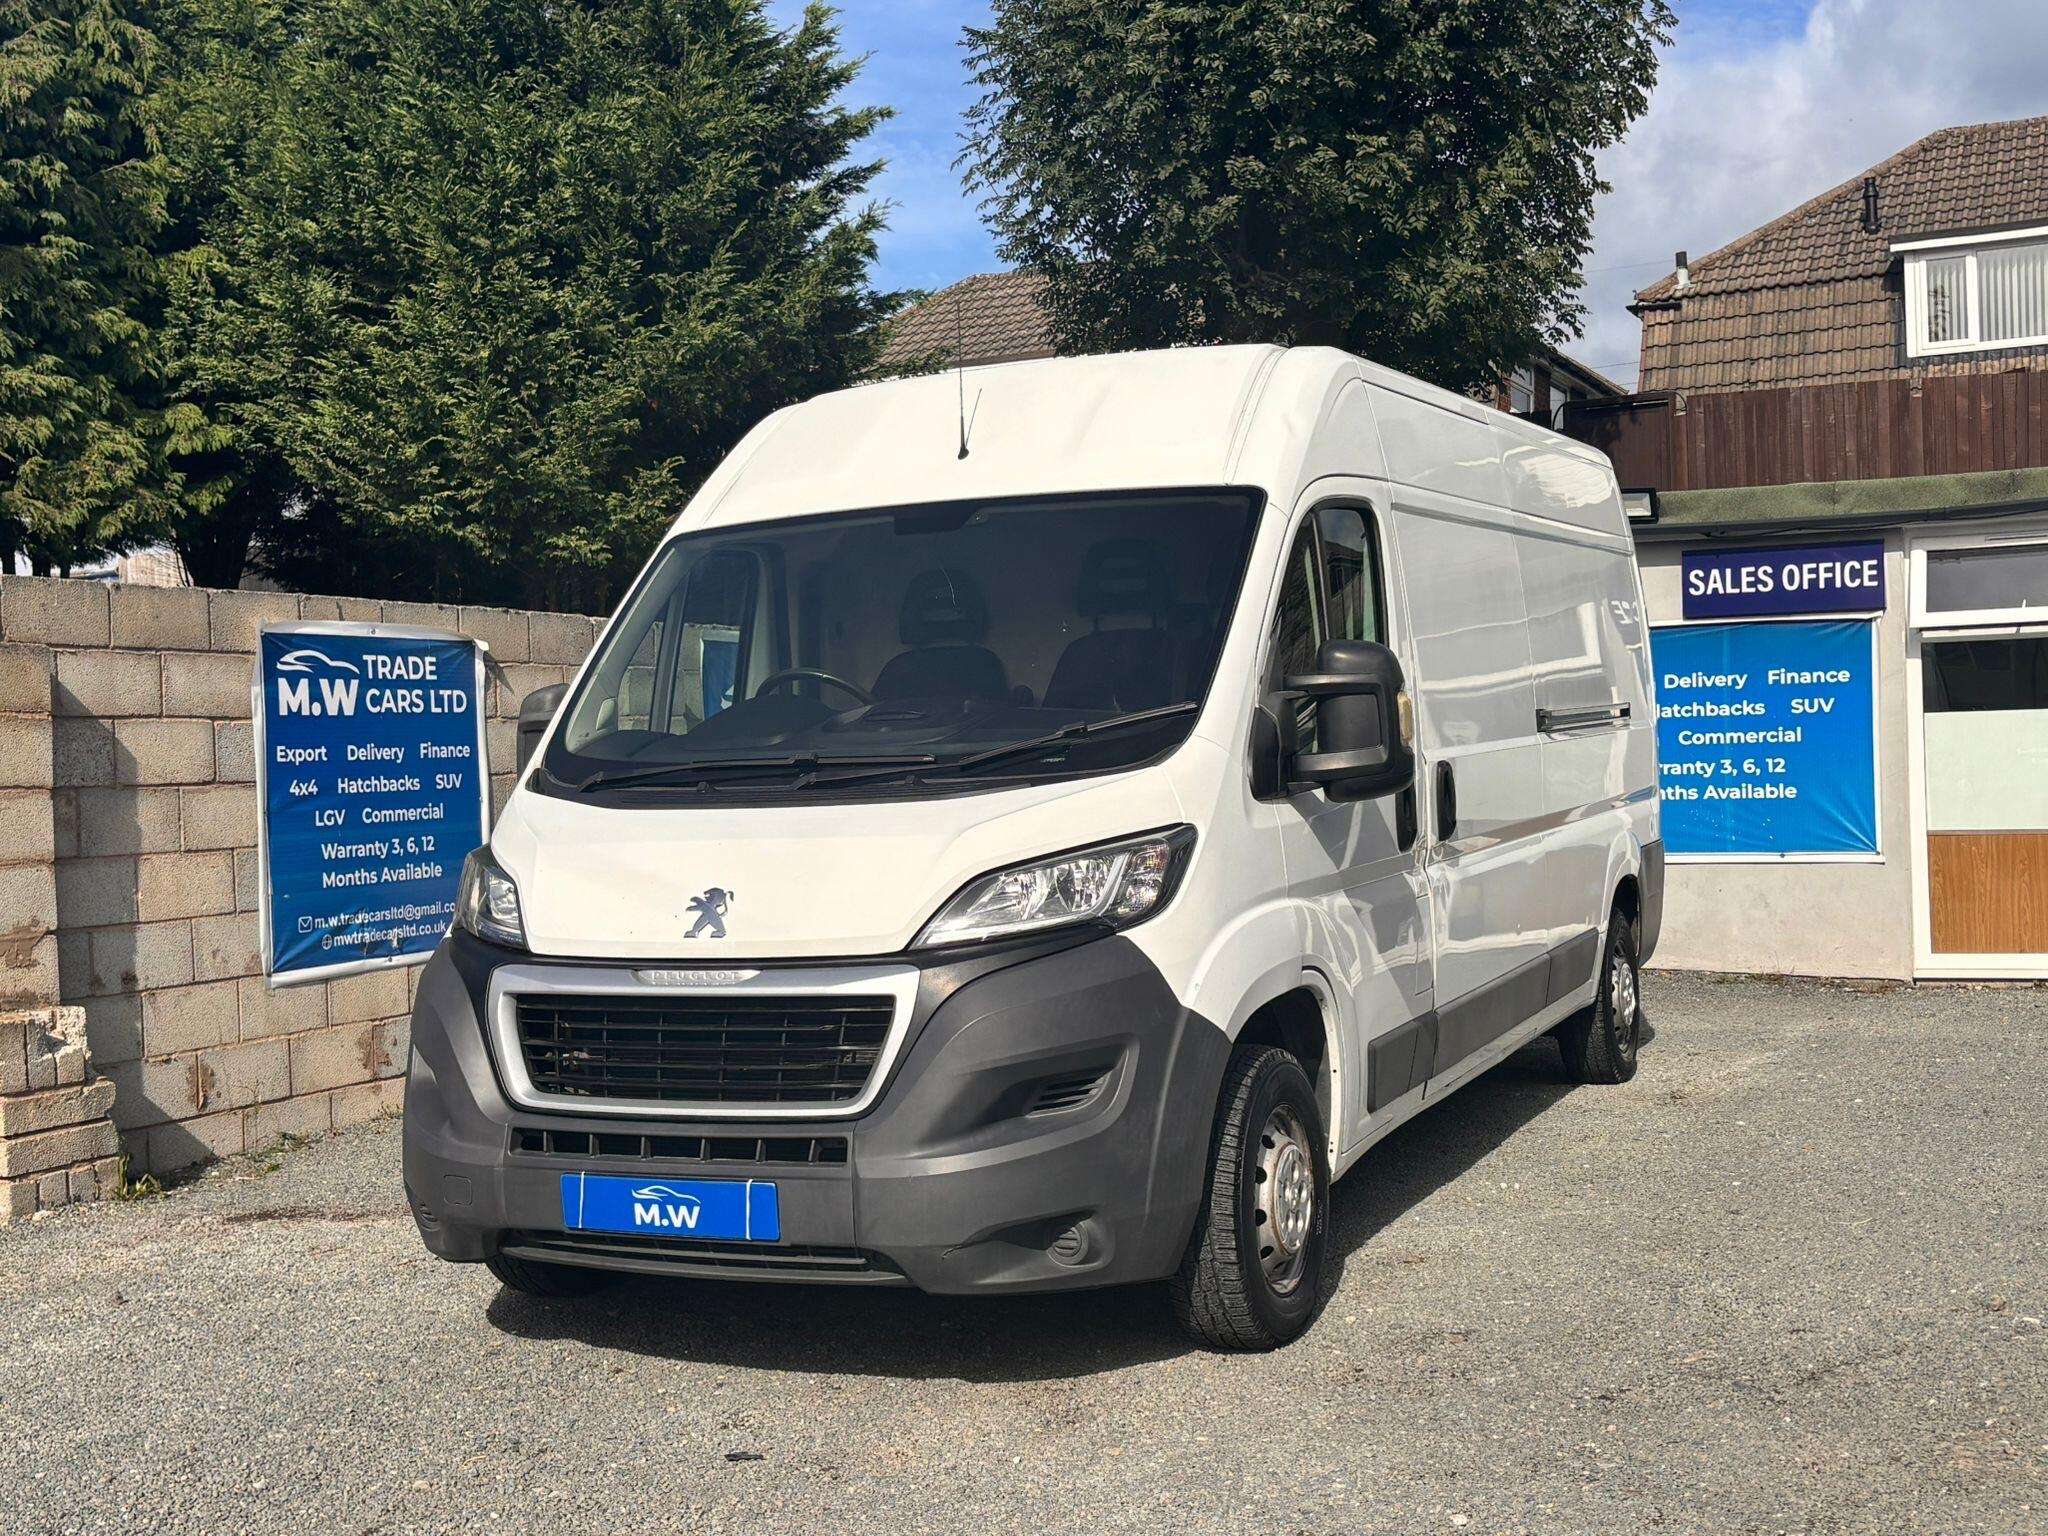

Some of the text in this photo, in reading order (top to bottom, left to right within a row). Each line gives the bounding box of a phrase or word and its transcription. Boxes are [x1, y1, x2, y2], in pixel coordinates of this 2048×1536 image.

[1688, 559, 1878, 596] SALES OFFICE
[362, 654, 437, 680] TRADE
[1664, 668, 1850, 689] Delivery Finance
[277, 677, 359, 716] M.W
[365, 687, 467, 713] CARS LTD
[1790, 698, 1834, 713] SUV
[1678, 726, 1801, 745] Commercial
[276, 741, 470, 765] Export Delivery Finance
[1659, 758, 1785, 777] ranty 3, 6, 12
[289, 773, 462, 796] 4x4 Hatchbacks SUV
[1659, 783, 1797, 800] ths Available
[315, 802, 443, 827] LGV Commercial
[321, 835, 435, 860] Warranty 3, 6, 12
[322, 861, 442, 888] Months Available
[314, 901, 455, 929] m.w.tradecarsltd@gmail.co
[650, 970, 740, 981] PEUGEOT
[633, 1202, 700, 1228] M.W
